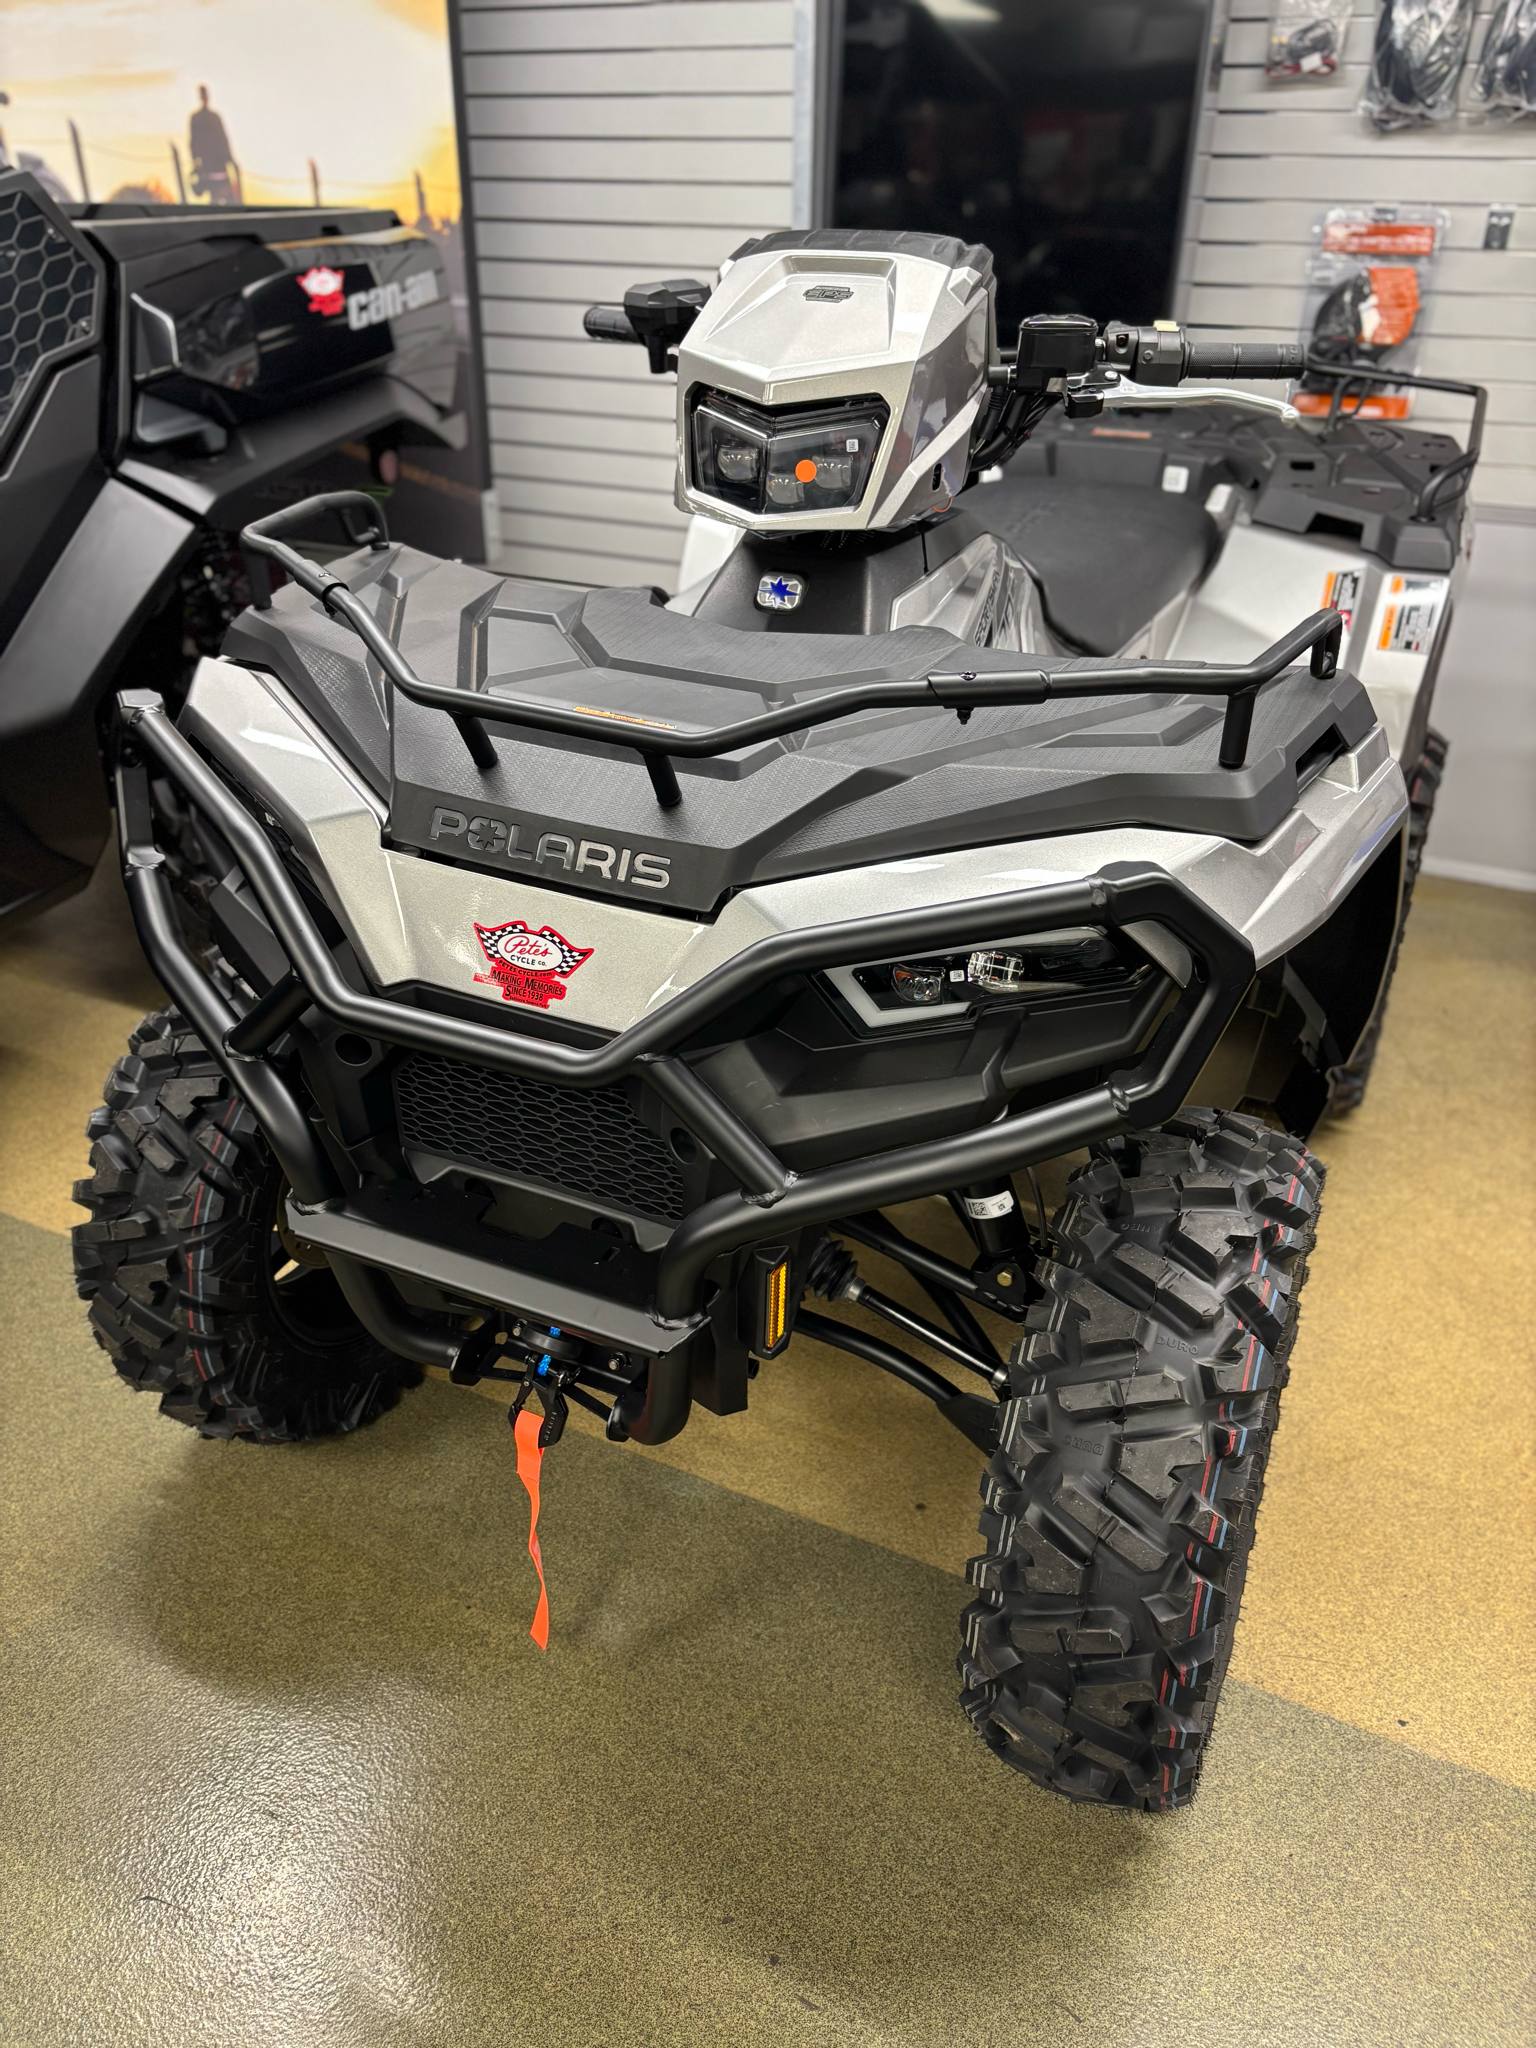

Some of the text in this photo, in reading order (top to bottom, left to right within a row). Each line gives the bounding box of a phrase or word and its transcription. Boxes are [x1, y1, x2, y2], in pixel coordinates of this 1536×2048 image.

[429, 806, 671, 889] POLARIS
[504, 935, 553, 957] Pete's
[510, 954, 536, 966] CYCLE
[527, 990, 544, 1001] 1938
